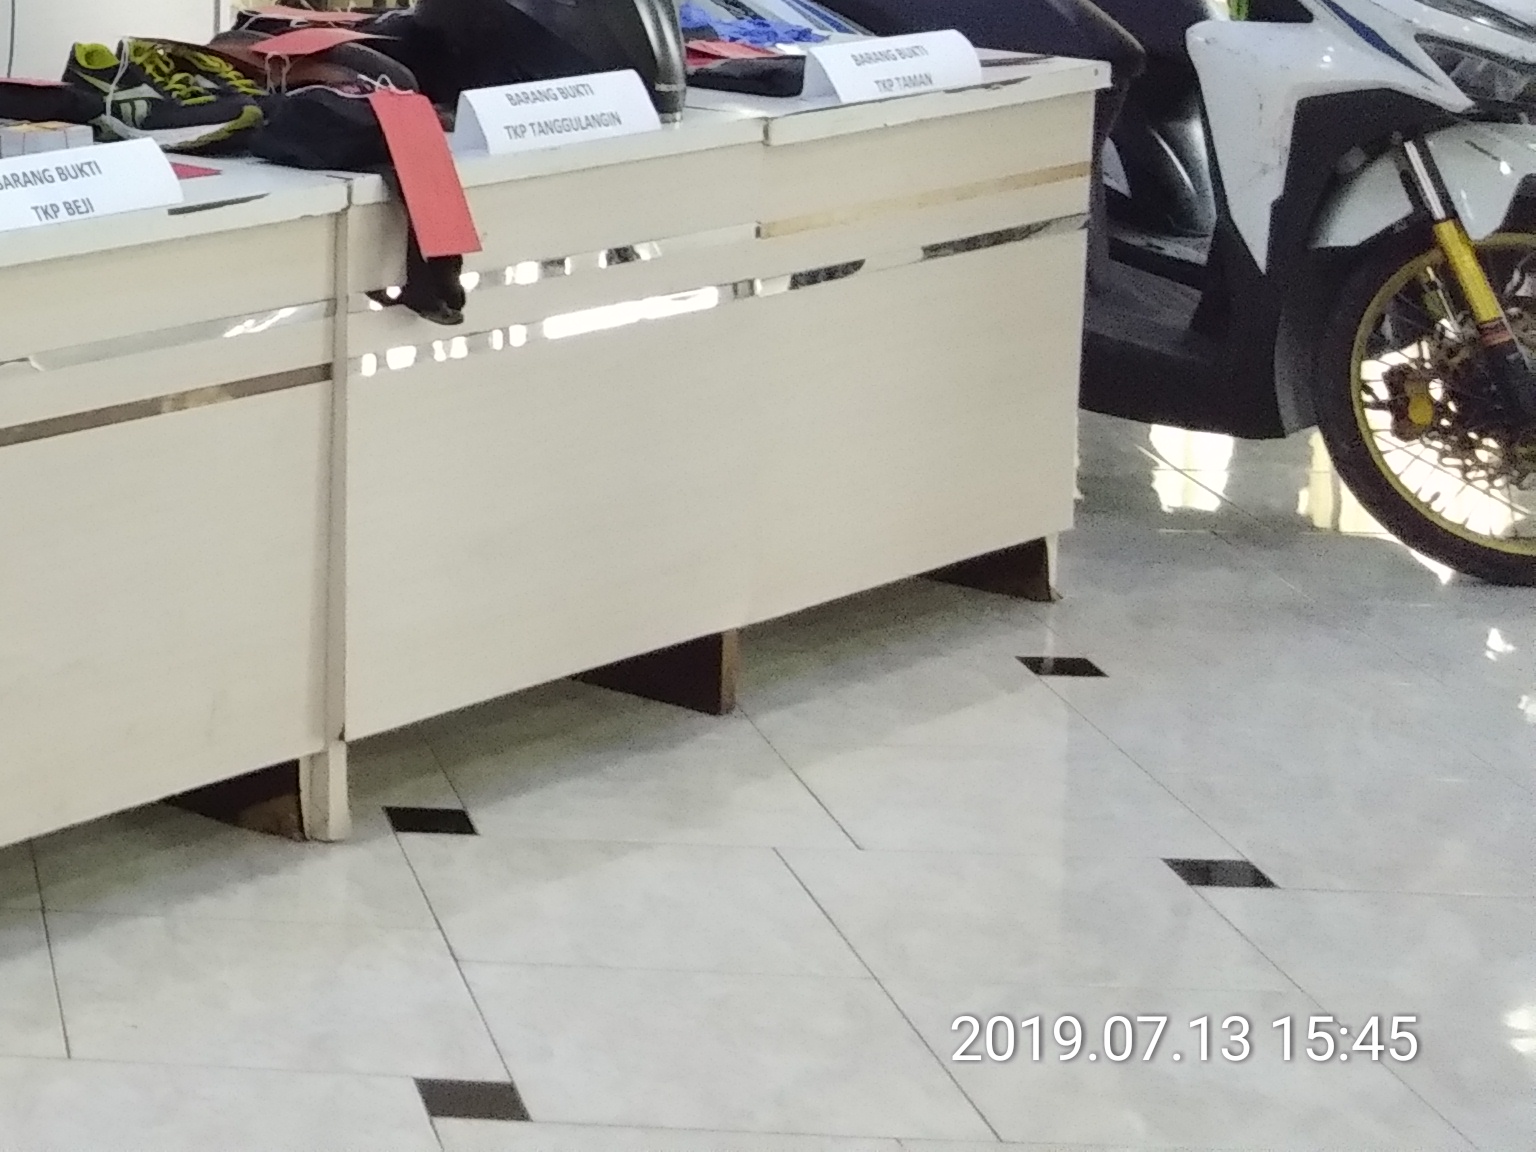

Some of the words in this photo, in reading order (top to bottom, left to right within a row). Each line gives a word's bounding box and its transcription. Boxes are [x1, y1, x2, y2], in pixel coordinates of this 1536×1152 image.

[851, 48, 898, 67] BARANG
[894, 45, 929, 60] BUKTI
[874, 78, 894, 92] TKP
[895, 73, 933, 89] TAMAN
[505, 87, 559, 106] BARANG
[556, 83, 595, 100] BUKTI
[504, 123, 527, 140] TKP
[529, 111, 622, 137] TANGGULANGIN
[54, 160, 102, 182] BUKTI
[30, 202, 60, 222] TKP
[62, 197, 95, 216] BEJI
